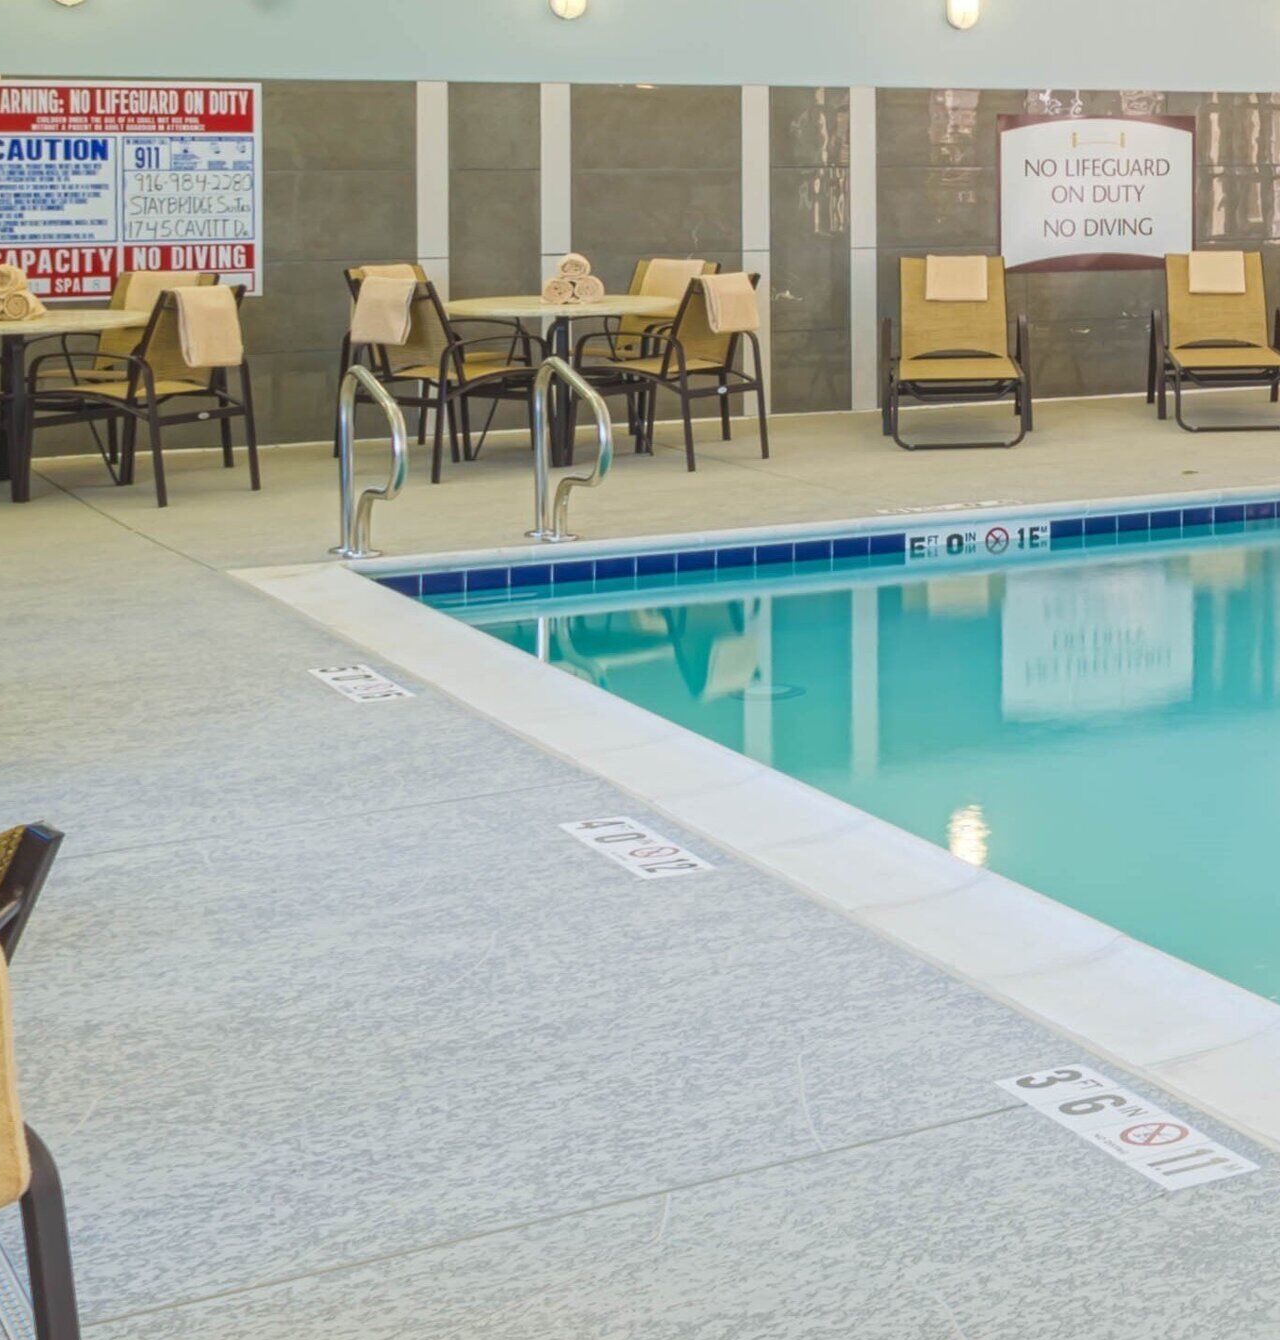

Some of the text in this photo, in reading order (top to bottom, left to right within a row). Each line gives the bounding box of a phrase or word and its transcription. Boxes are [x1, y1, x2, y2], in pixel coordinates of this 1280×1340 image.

[69, 89, 91, 114] NO
[96, 89, 179, 115] LIFEGUARD
[183, 90, 204, 115] ON
[209, 91, 249, 116] DUTY
[135, 146, 160, 169] 911
[1024, 158, 1171, 177] NO LIFEGUARD
[1051, 184, 1146, 203] ON DUTY
[128, 220, 172, 239] 1745
[1043, 217, 1153, 237] NO DIVING
[132, 245, 246, 270] NO DIVING
[55, 278, 81, 294] SPA
[1016, 1069, 1083, 1089] 3
[1058, 1094, 1128, 1116] 6
